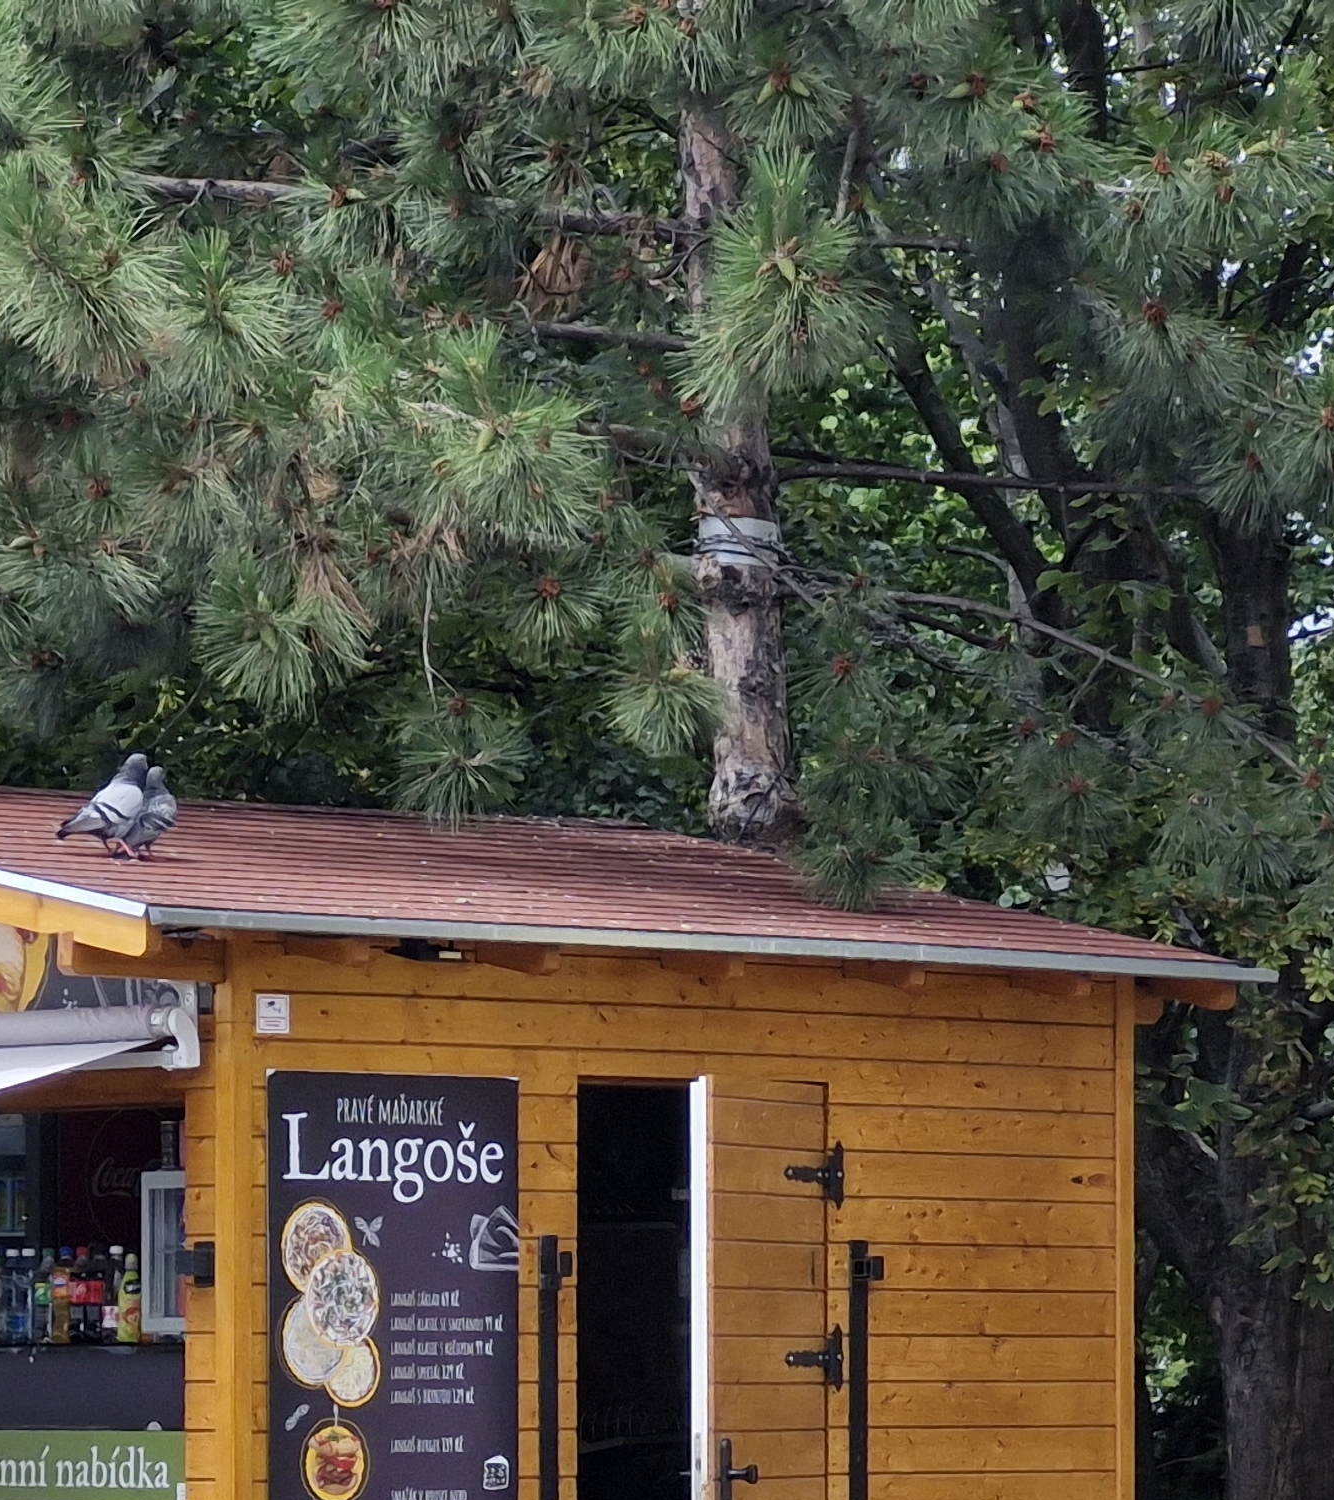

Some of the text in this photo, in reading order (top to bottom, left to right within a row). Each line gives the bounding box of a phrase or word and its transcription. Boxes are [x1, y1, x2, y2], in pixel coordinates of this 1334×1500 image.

[337, 1093, 445, 1126] PRAVÉ MAĎARSKÉ
[281, 1112, 504, 1203] Langoše
[55, 1445, 169, 1489] nabídka
